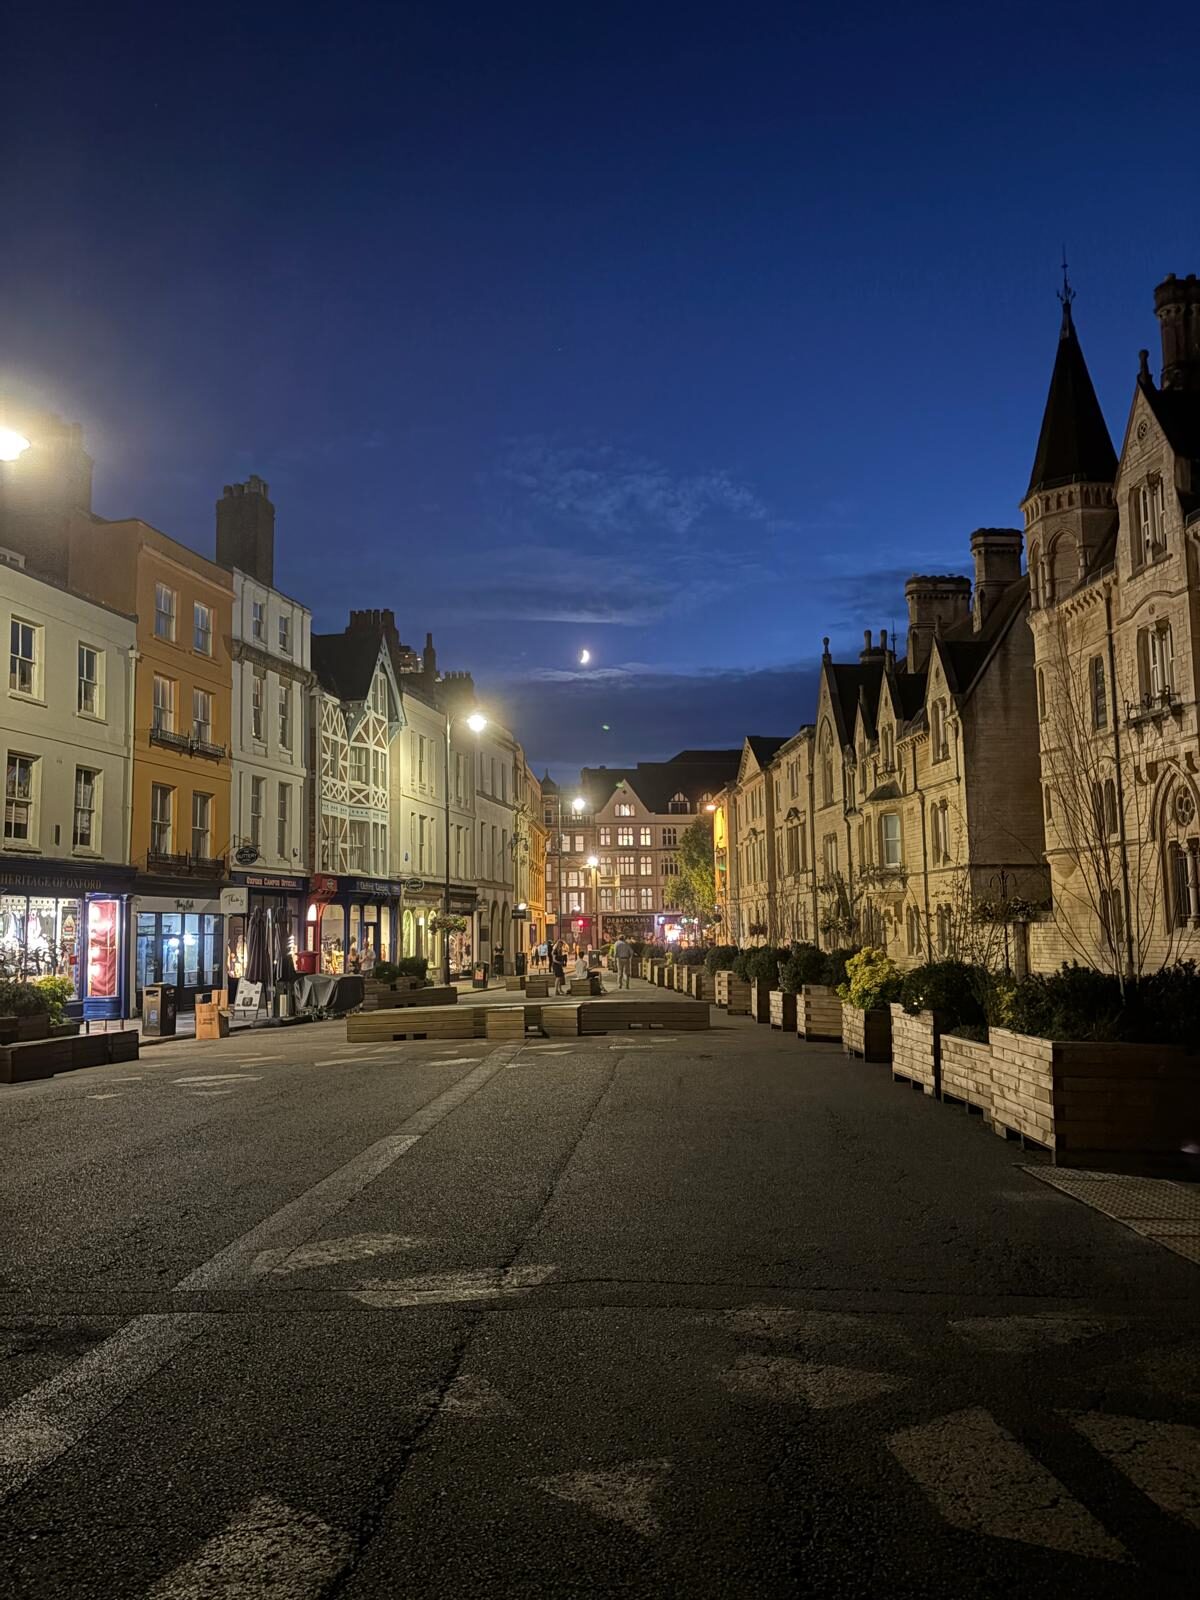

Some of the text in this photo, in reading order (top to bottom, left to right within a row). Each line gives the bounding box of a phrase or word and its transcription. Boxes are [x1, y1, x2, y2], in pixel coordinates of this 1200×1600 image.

[1, 873, 102, 889] HERITAGE OF OXFORD
